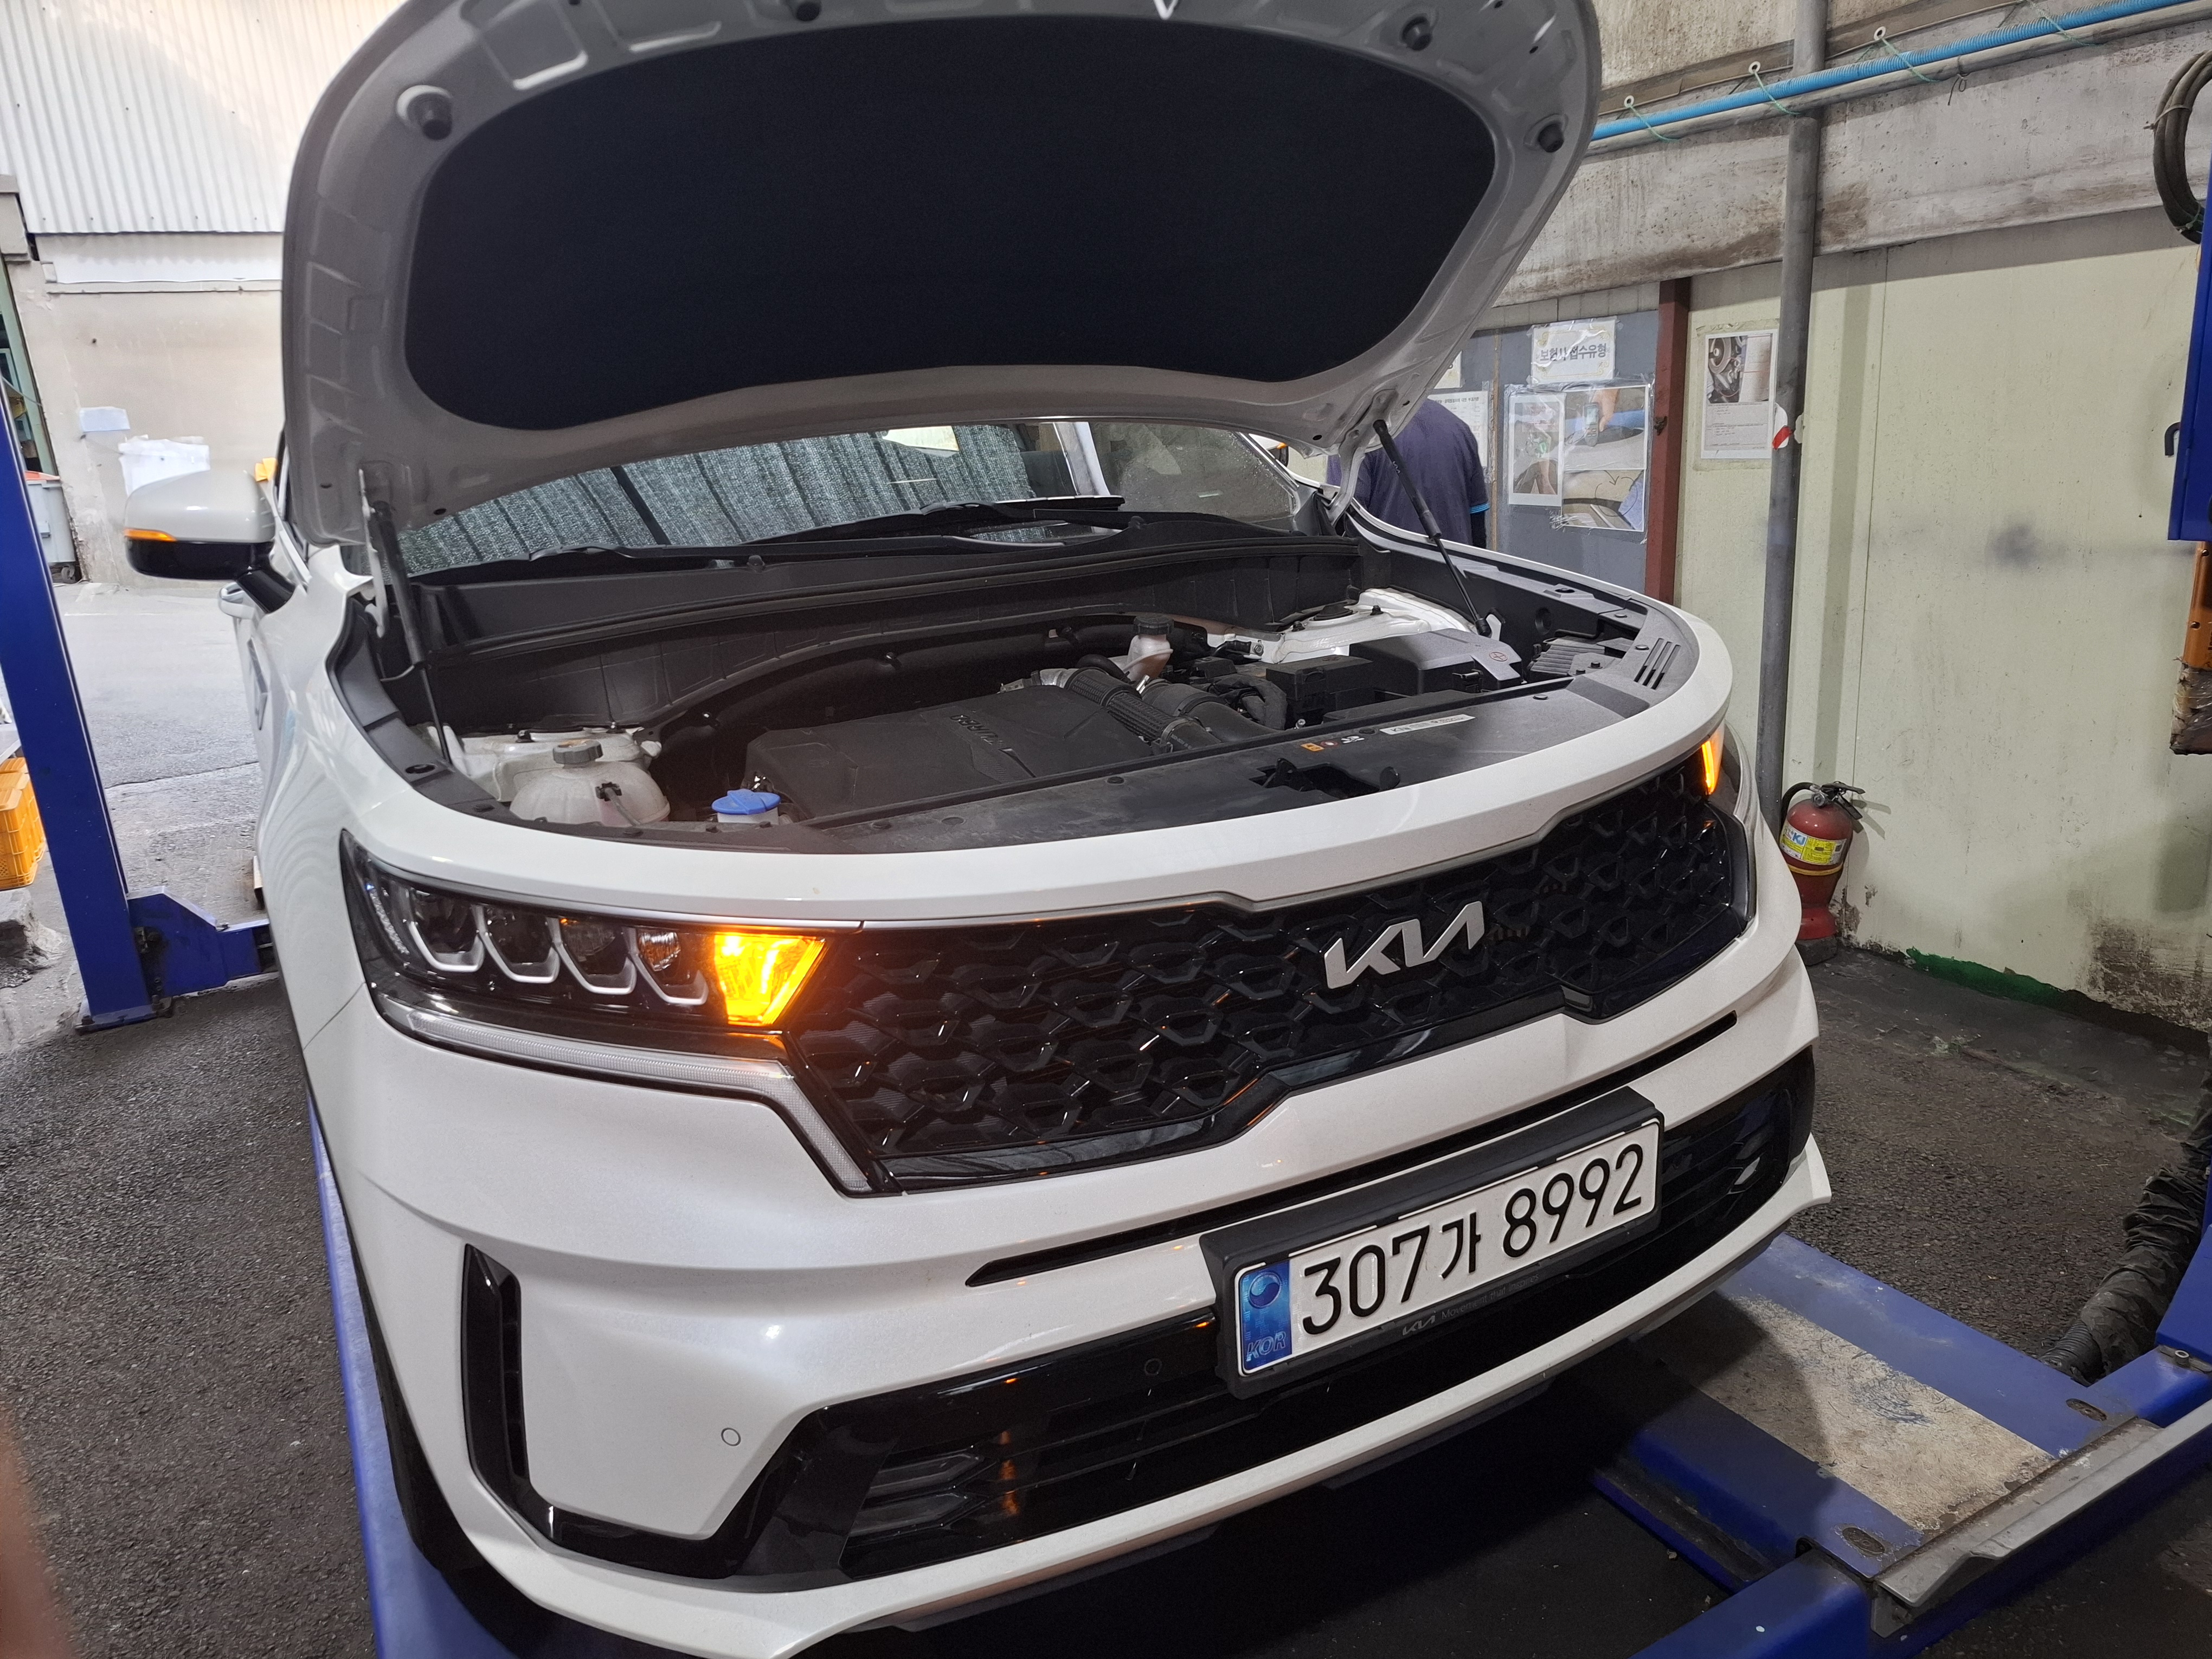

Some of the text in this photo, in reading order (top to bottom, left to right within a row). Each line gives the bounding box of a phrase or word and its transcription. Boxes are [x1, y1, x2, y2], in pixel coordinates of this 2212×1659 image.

[1303, 1143, 1643, 1335] 307가 8992
[1246, 1331, 1287, 1360] KOR
